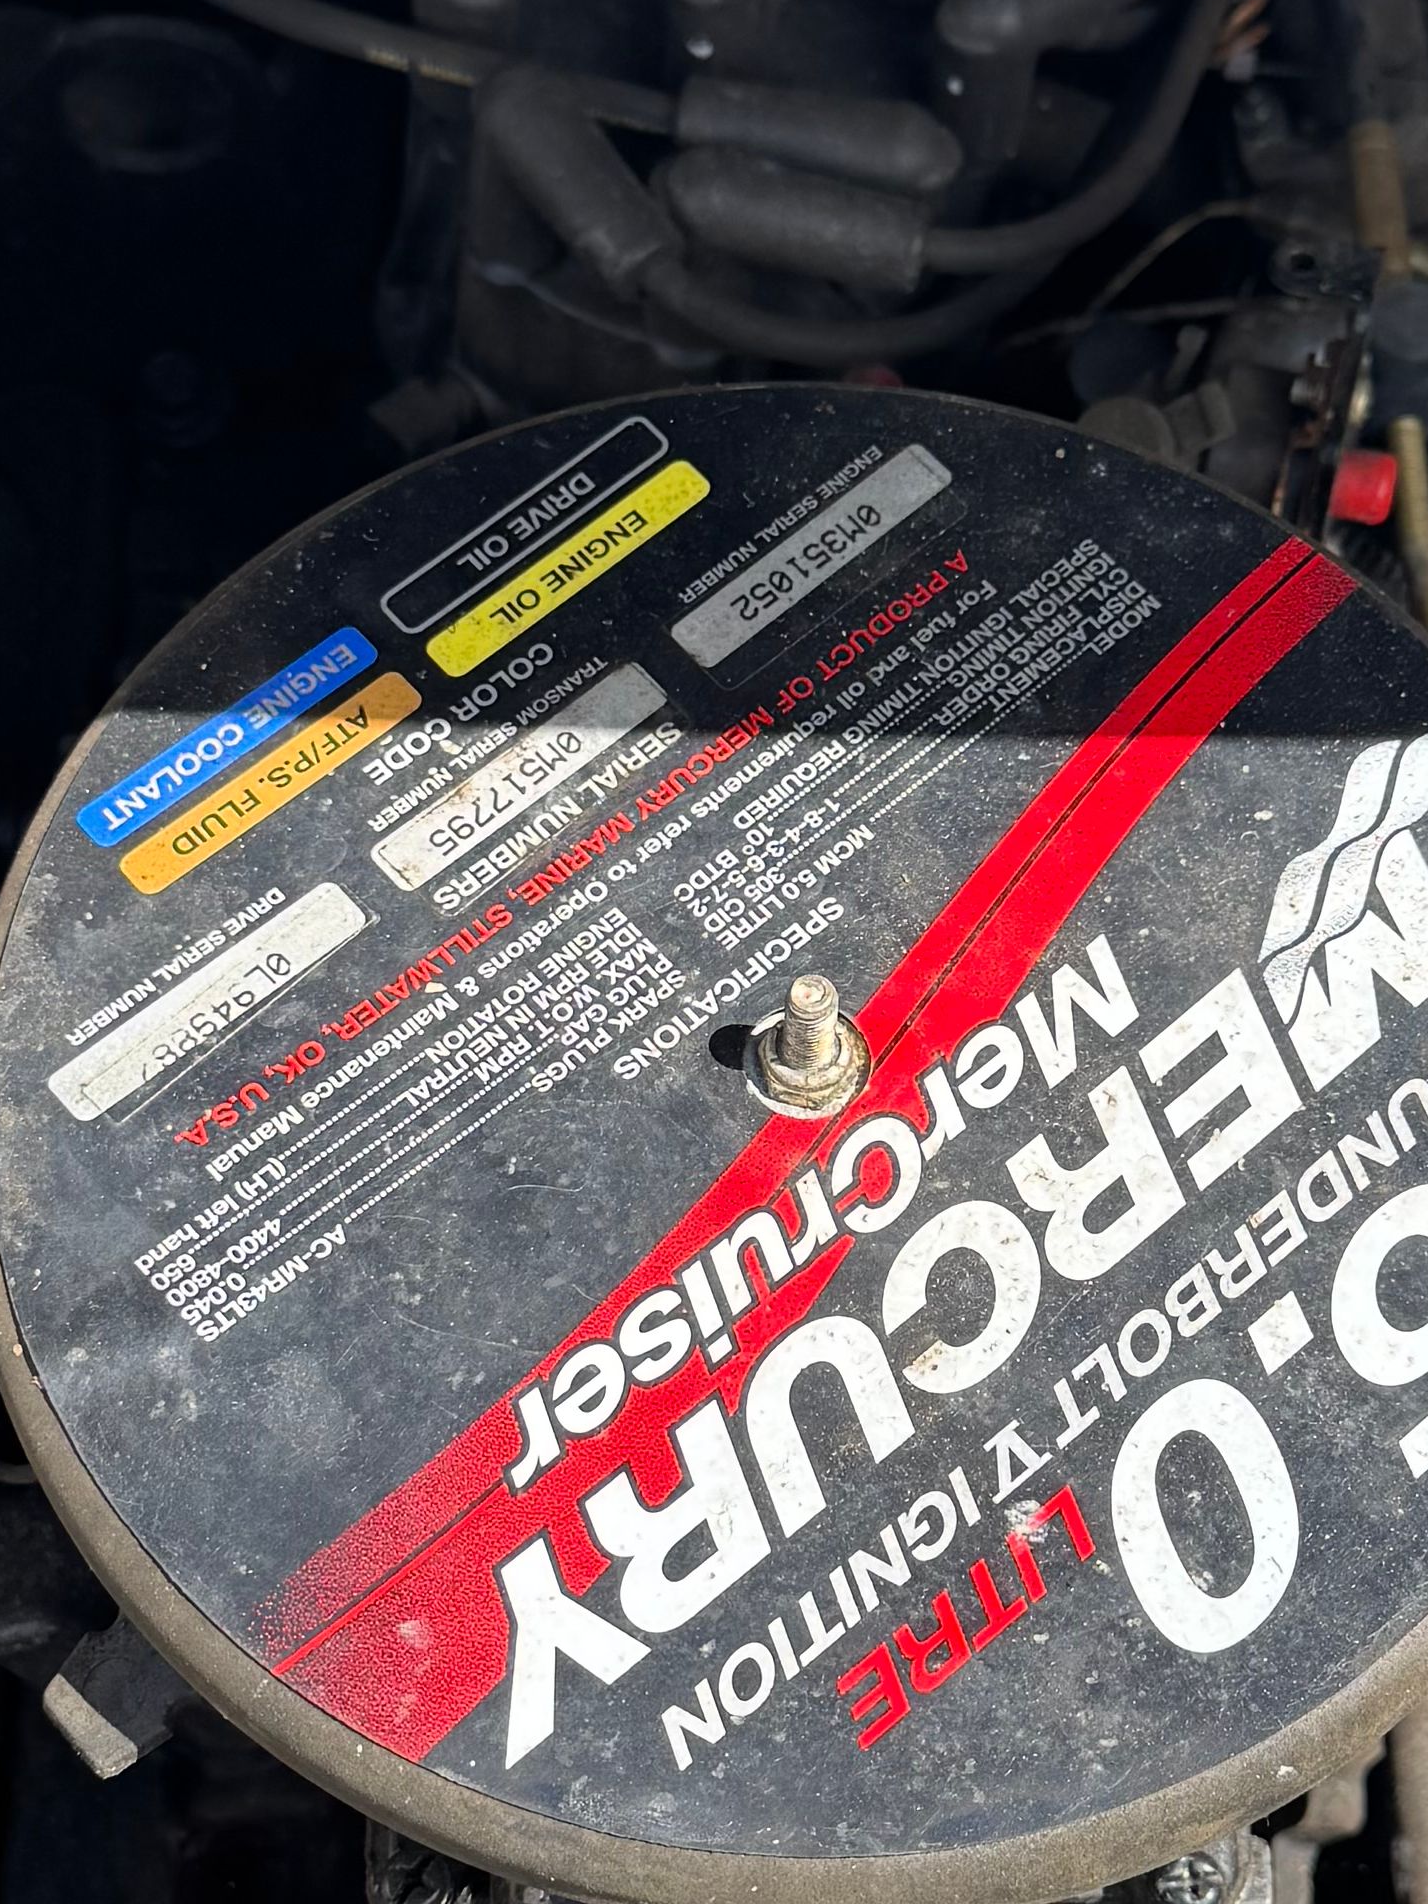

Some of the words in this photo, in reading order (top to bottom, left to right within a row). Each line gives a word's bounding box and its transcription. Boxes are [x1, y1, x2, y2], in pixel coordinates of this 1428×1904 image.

[506, 469, 596, 542] DRIVE
[815, 444, 883, 500] ENGINE
[537, 506, 648, 596] ENGINE
[753, 493, 819, 545] SERIAL
[454, 531, 511, 575] OIL
[677, 540, 757, 604] NUMBER
[729, 500, 882, 623] 0M351052
[942, 548, 967, 578] A
[1007, 536, 1099, 609] SPECIAL
[1077, 564, 1130, 609] CYL.
[487, 584, 542, 630] OIL
[952, 579, 996, 617] For
[1019, 550, 1115, 630] IGNITION
[813, 569, 948, 679] PRODUCT
[908, 609, 956, 652] fuel
[917, 606, 1013, 685] IGNITION
[1008, 603, 1081, 666] FIRING
[242, 641, 356, 731] ENGINE
[447, 638, 555, 725] COLOR
[515, 654, 607, 726] TRANSOM
[771, 673, 815, 714] OF
[834, 678, 868, 710] oil
[864, 643, 912, 687] and
[451, 719, 517, 770] SERIAL
[841, 679, 920, 746] TIMING
[100, 717, 247, 832] COOLANT
[258, 706, 372, 797] ATF/P.S.
[362, 713, 454, 787] CODE
[576, 718, 683, 803] SERIAL
[634, 706, 773, 822] MERCURY
[689, 701, 838, 820] requirements
[366, 766, 452, 833] NUMBER
[426, 728, 583, 857] 0M517795
[730, 738, 845, 831] REQUIRED
[168, 787, 260, 859] FLUID
[430, 794, 582, 914] NUMBERS
[632, 812, 691, 862] refer
[685, 794, 842, 918] 1-8-4-3-6-5-7-2
[812, 822, 875, 876] MCM
[507, 808, 634, 907] MARINE,
[605, 855, 640, 887] to
[670, 847, 738, 905] BTDC
[779, 867, 817, 903] 5.0
[223, 886, 284, 935] DRIVE
[476, 875, 610, 982] Operations
[537, 905, 627, 979] ENGINE
[700, 894, 747, 935] CID
[715, 892, 784, 951] LITRE
[152, 927, 226, 983] SERIAL
[320, 901, 514, 1043] STILLWATER,
[583, 921, 642, 971] IDLE
[594, 936, 657, 988] MAX.
[64, 977, 156, 1047] NUMBER
[452, 973, 481, 1002] &
[526, 980, 600, 1040] W.O.T.
[531, 961, 589, 1012] RPM
[604, 952, 672, 1009] PLUG
[607, 968, 687, 1034] SPARK
[610, 894, 845, 1082] SPECIFICATIONS
[299, 990, 459, 1111] Maintenance
[504, 1003, 534, 1032] IN
[263, 1035, 326, 1084] OK,
[173, 1078, 269, 1149] U.S.A.
[204, 1103, 303, 1182] Manual
[193, 1193, 238, 1232] left
[510, 933, 1137, 1500] MerCruiser
[133, 1221, 199, 1276] hand
[147, 1250, 197, 1293] 650
[163, 1214, 285, 1309] 4400-4800
[178, 1269, 247, 1326] 0.045
[193, 1222, 348, 1344] AC-MR43LTS
[976, 1414, 1066, 1506] V
[661, 1465, 974, 1772] IGNITION
[831, 1480, 1098, 1752] LITRE
